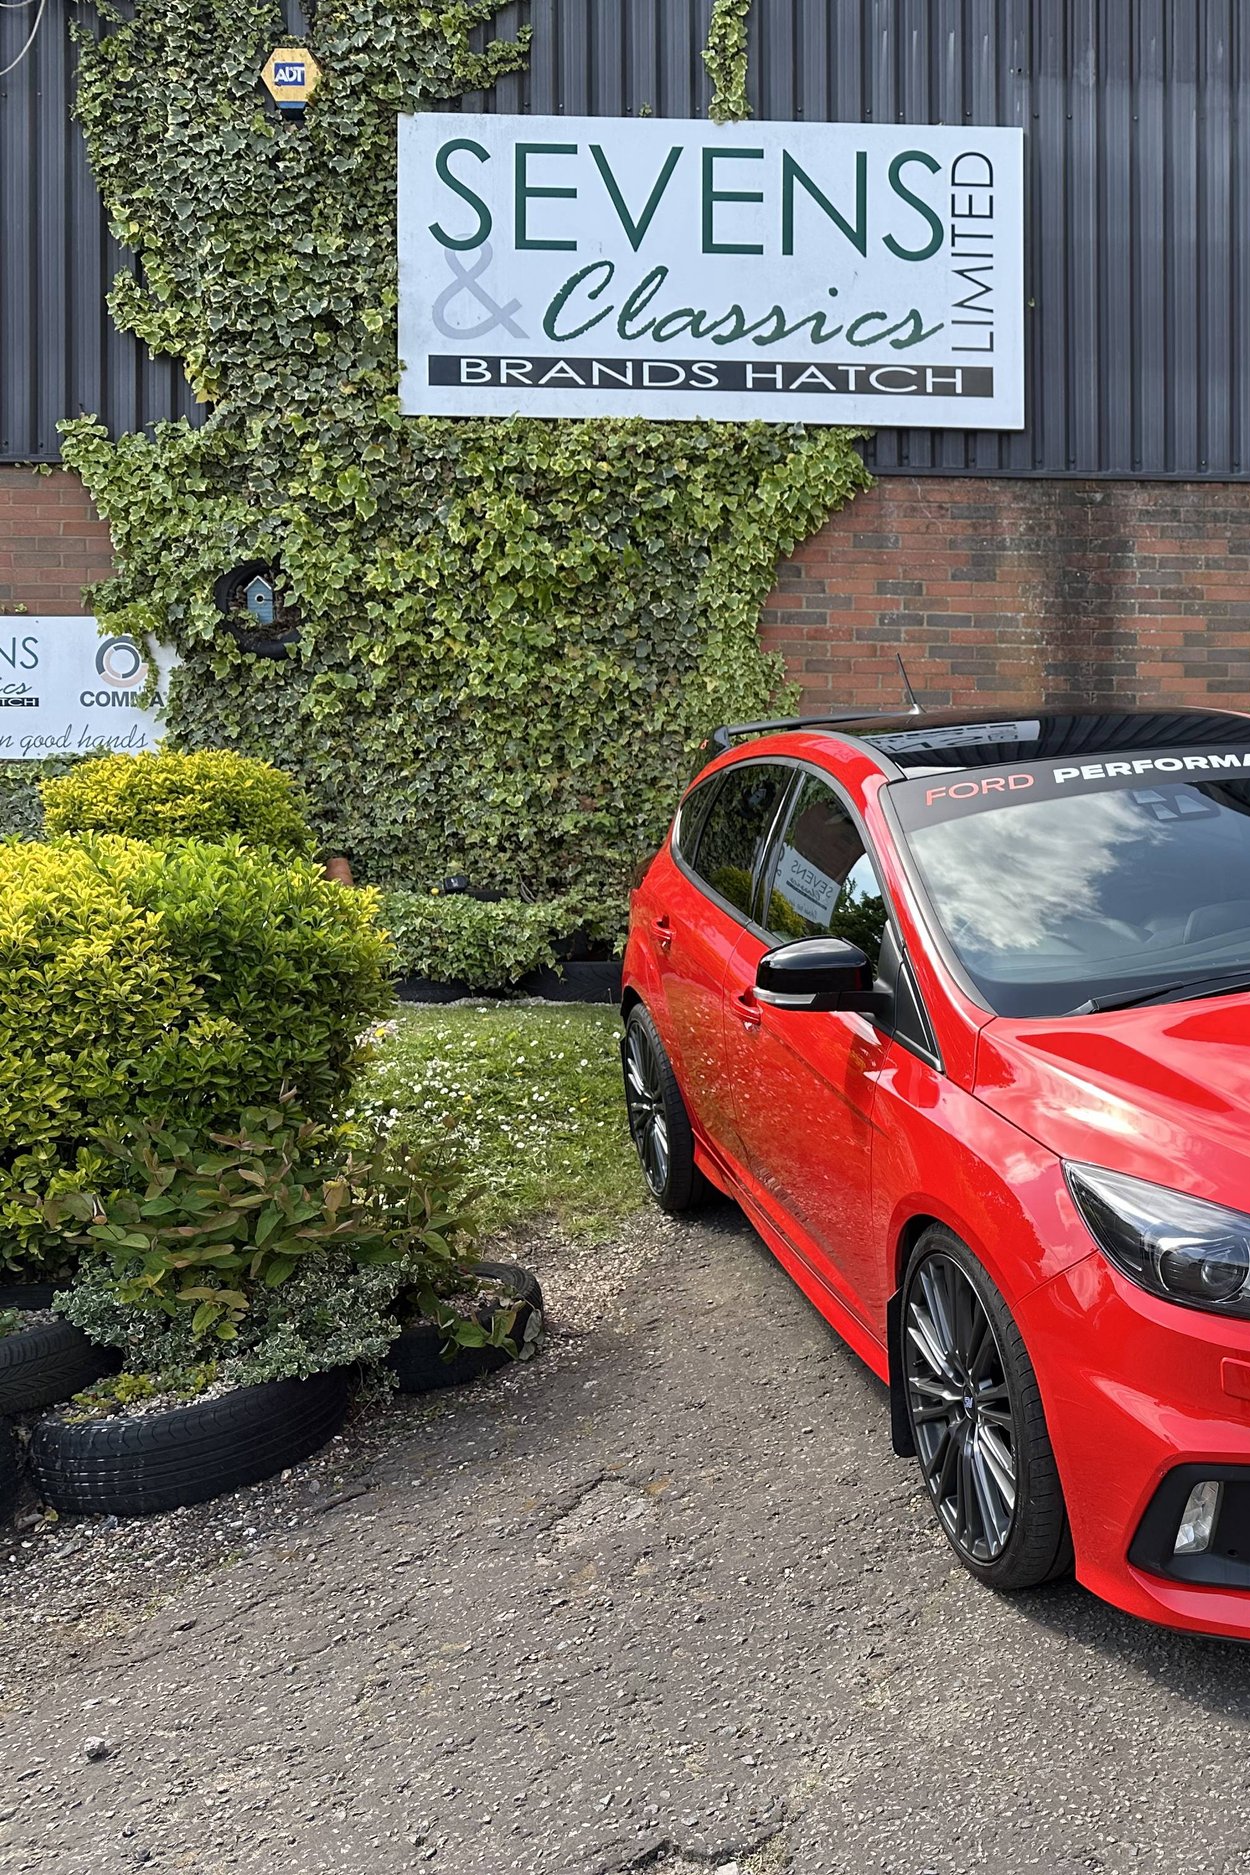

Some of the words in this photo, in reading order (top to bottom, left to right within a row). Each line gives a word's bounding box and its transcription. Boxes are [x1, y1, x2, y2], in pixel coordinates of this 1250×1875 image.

[275, 66, 305, 82] ADT
[428, 138, 944, 262] SEVENS
[951, 151, 994, 352] LIMITED
[432, 233, 530, 340] &
[543, 260, 944, 350] Classics
[460, 358, 719, 388] BRANDS
[746, 363, 962, 394] HATCH
[80, 690, 164, 707] COMA
[20, 724, 72, 757] good
[77, 724, 149, 749] hands
[926, 773, 1035, 806] FORD
